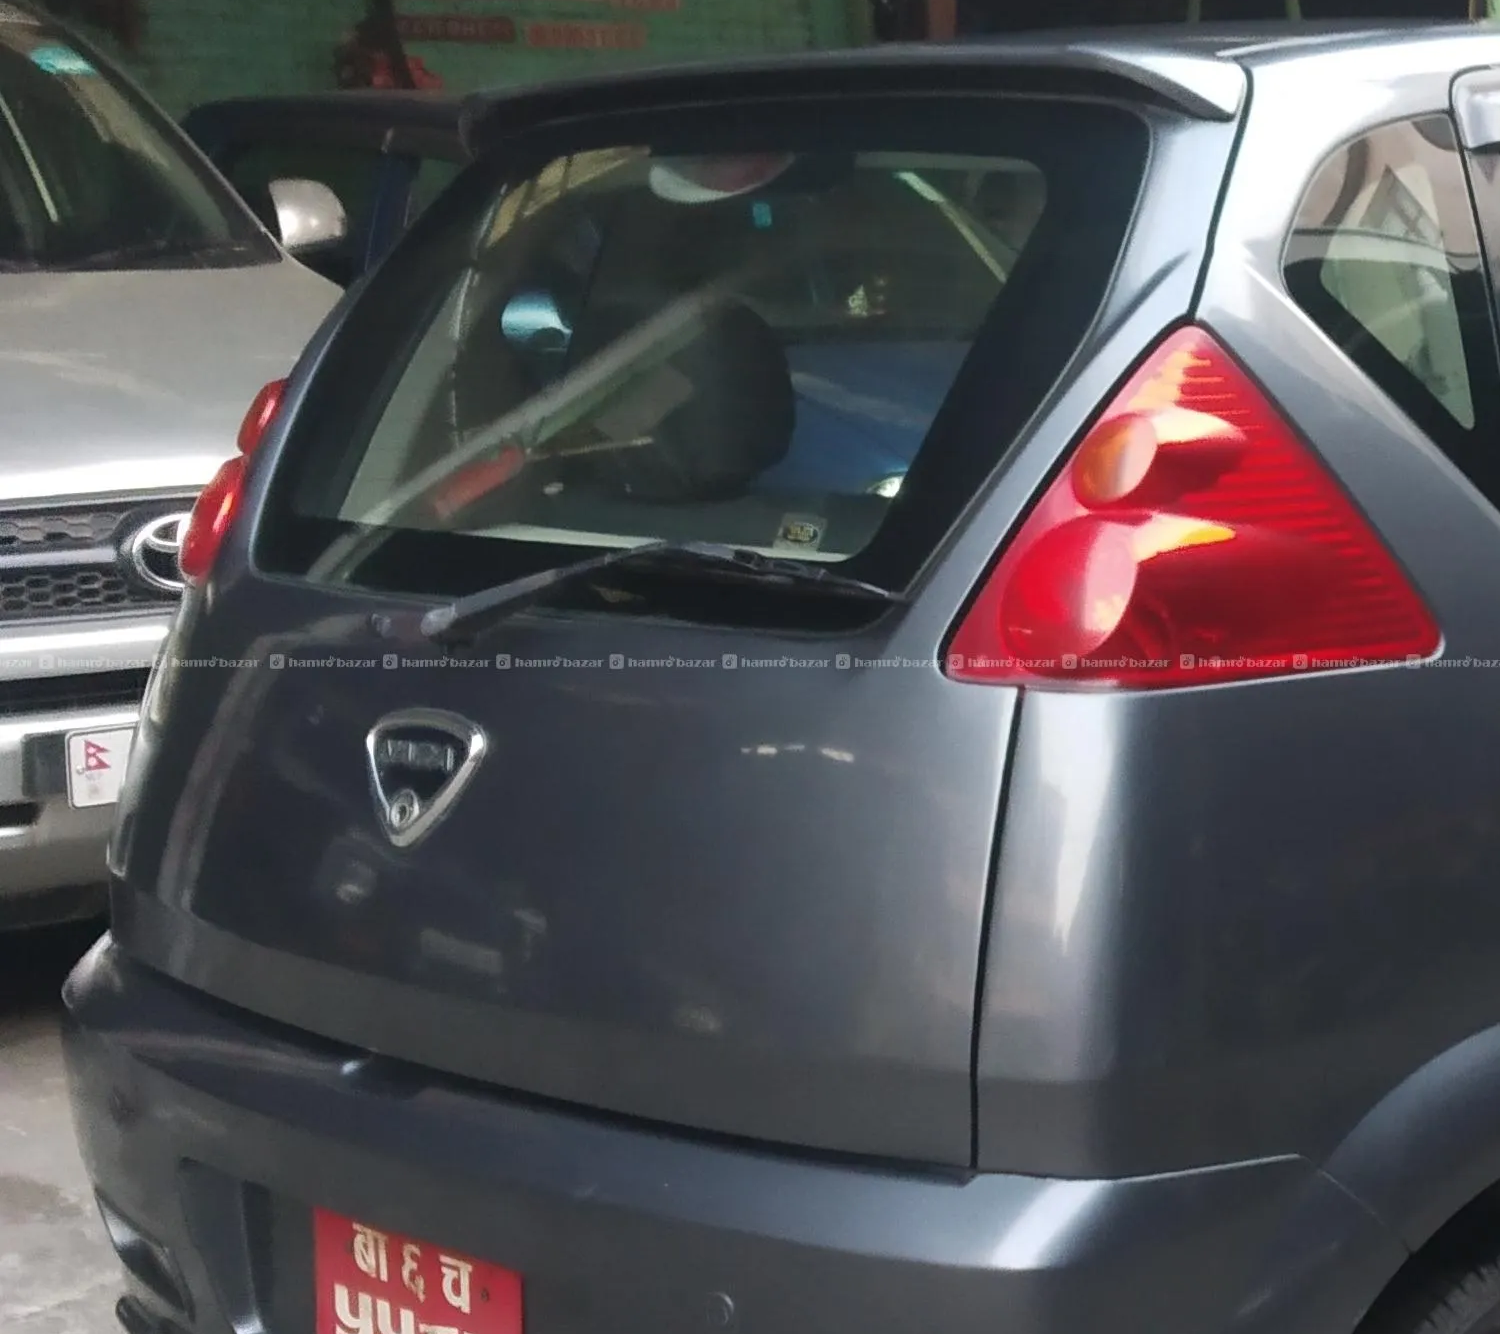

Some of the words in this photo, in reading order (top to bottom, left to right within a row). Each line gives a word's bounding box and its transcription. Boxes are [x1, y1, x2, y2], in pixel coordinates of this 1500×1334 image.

[353, 1222, 388, 1283] बा
[402, 1243, 426, 1303] ६
[439, 1254, 473, 1314] च
